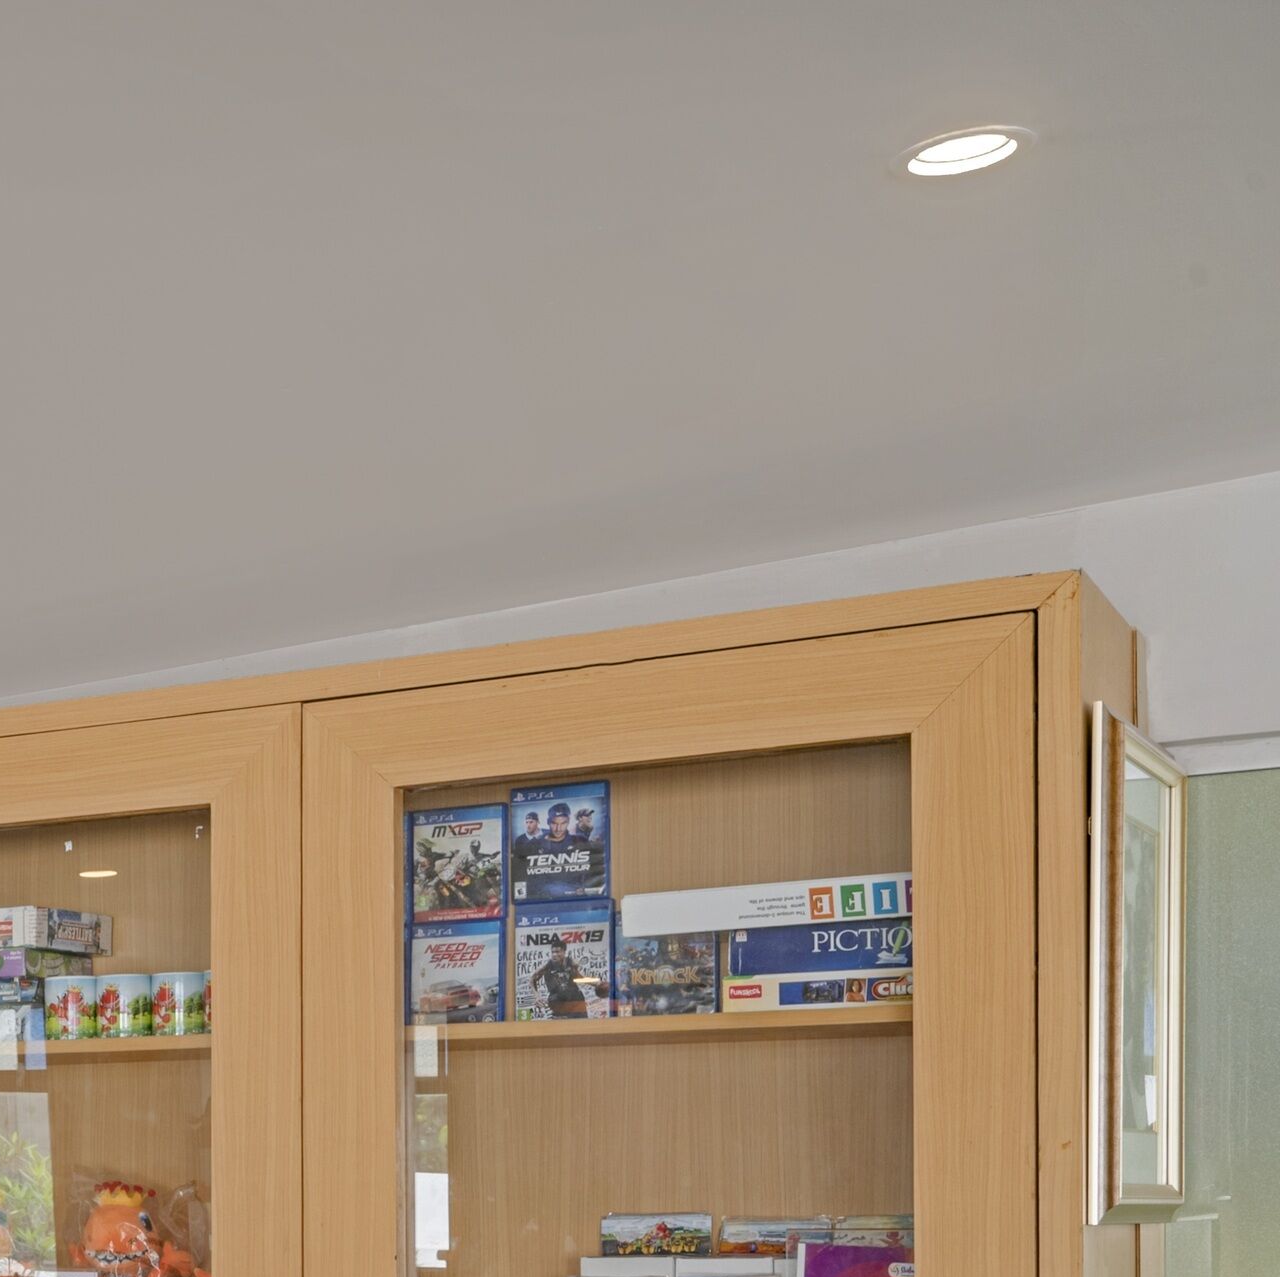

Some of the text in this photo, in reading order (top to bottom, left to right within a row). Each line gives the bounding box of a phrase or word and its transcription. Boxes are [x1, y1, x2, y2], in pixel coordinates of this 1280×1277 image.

[527, 791, 554, 799] PS4
[428, 814, 454, 823] PS4
[432, 822, 483, 839] MXGP
[527, 849, 590, 867] TENNIS
[527, 864, 590, 875] WORLD TOUR
[812, 887, 912, 915] IFE
[532, 916, 560, 925] PS4
[427, 929, 453, 937] PS4
[424, 942, 486, 954] NEED FOR
[430, 951, 482, 963] SPEED
[434, 962, 475, 970] PAYBACK
[630, 965, 700, 986] KNACK
